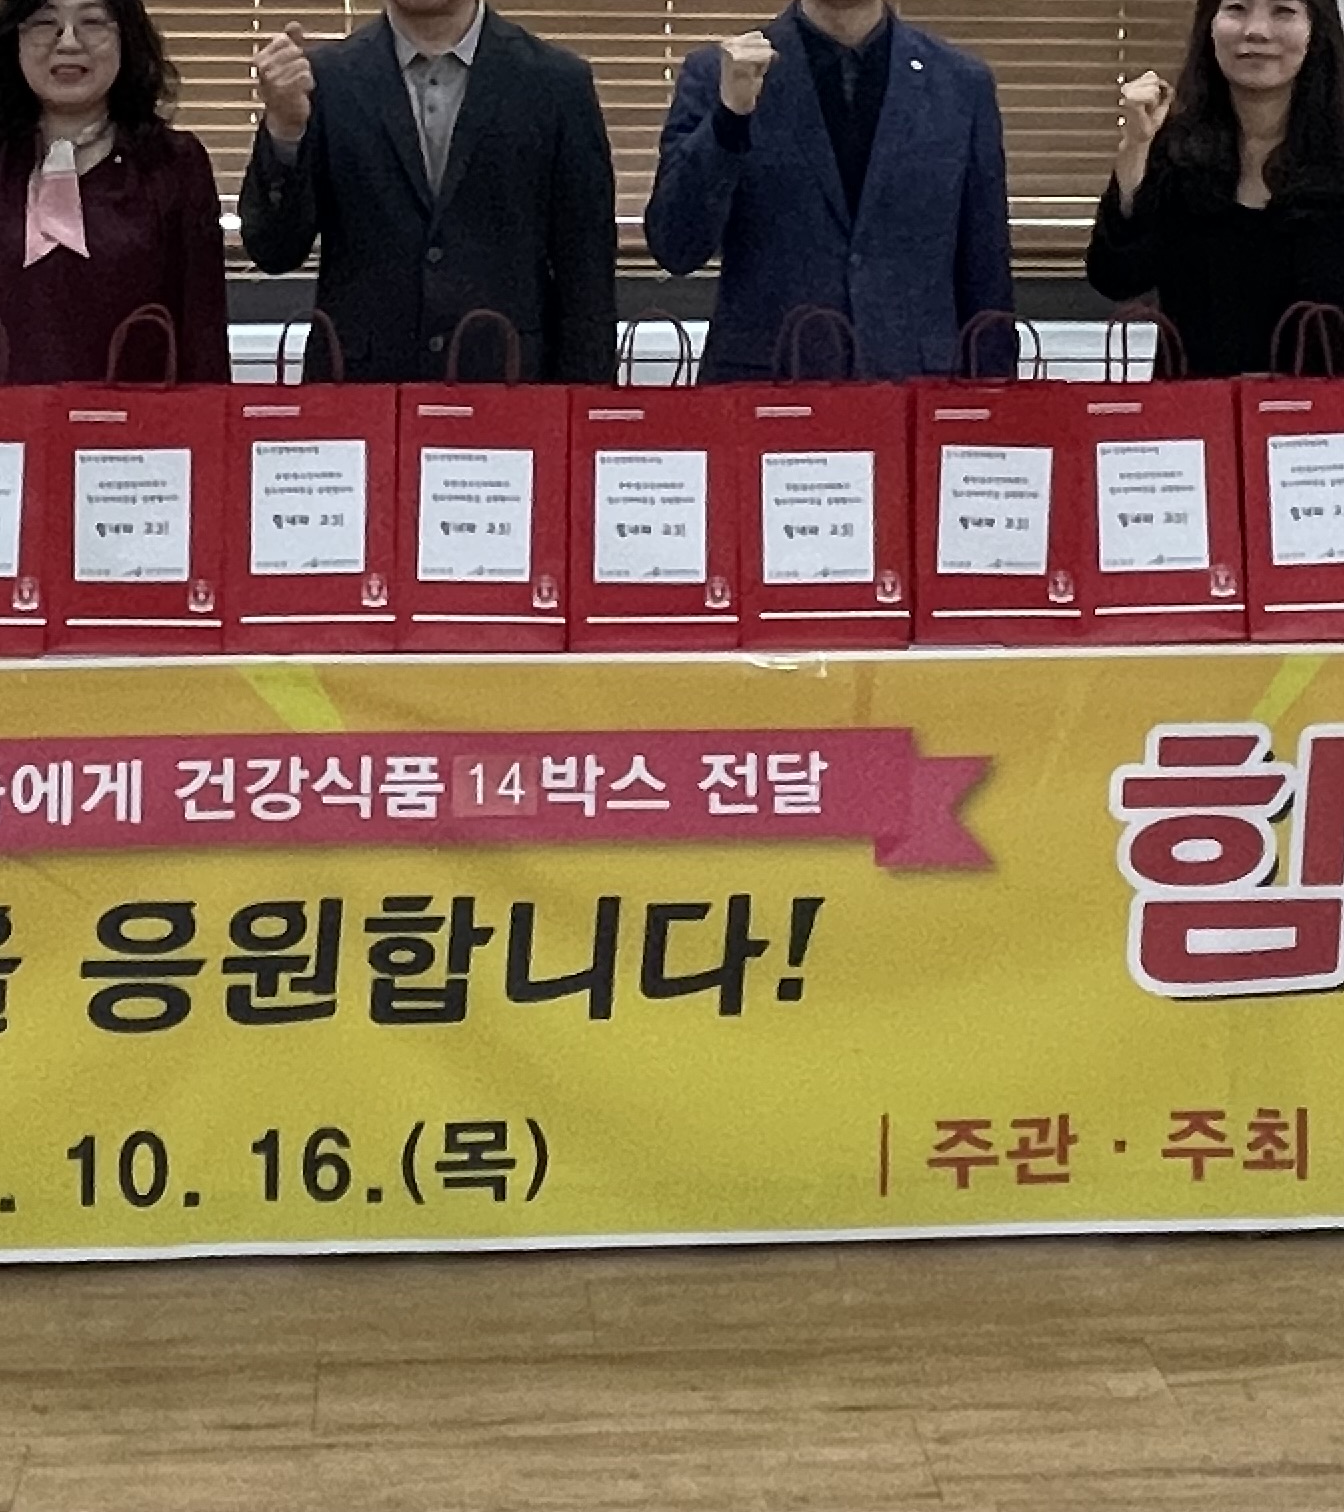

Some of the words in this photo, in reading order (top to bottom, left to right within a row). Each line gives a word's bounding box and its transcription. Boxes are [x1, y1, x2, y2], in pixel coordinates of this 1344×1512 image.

[697, 751, 828, 813] 전달
[81, 895, 825, 1033] 응원합니다!
[68, 1131, 199, 1207] 10.
[928, 1114, 1077, 1188] 주관
[1162, 1108, 1308, 1181] 주최
